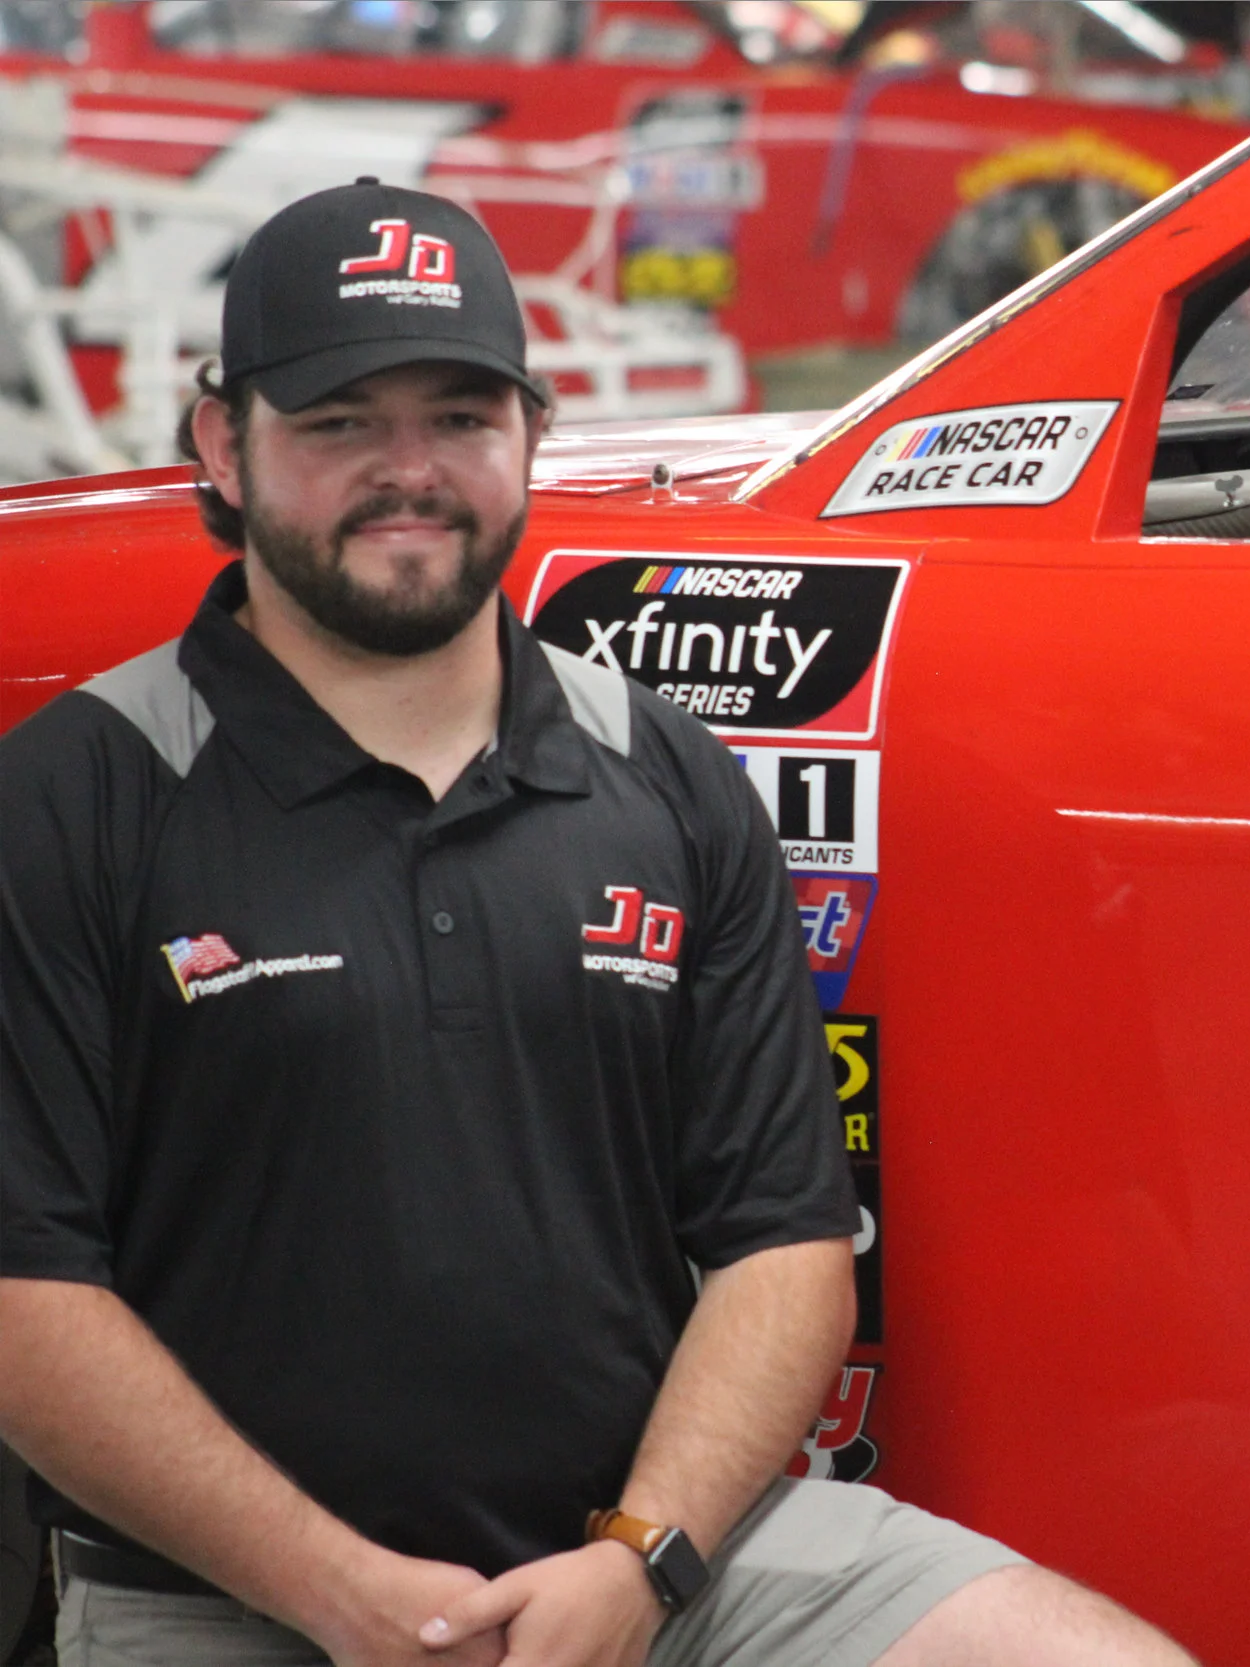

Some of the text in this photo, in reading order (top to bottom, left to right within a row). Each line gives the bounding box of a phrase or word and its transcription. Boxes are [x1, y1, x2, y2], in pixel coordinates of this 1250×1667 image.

[338, 279, 462, 299] MOTORSPORTS
[926, 415, 1072, 457] NASCAR
[865, 461, 1044, 497] RACE CAR
[672, 566, 803, 599] NASCAR
[581, 601, 833, 699] xfinity
[582, 953, 679, 984] MOTORSPORTS
